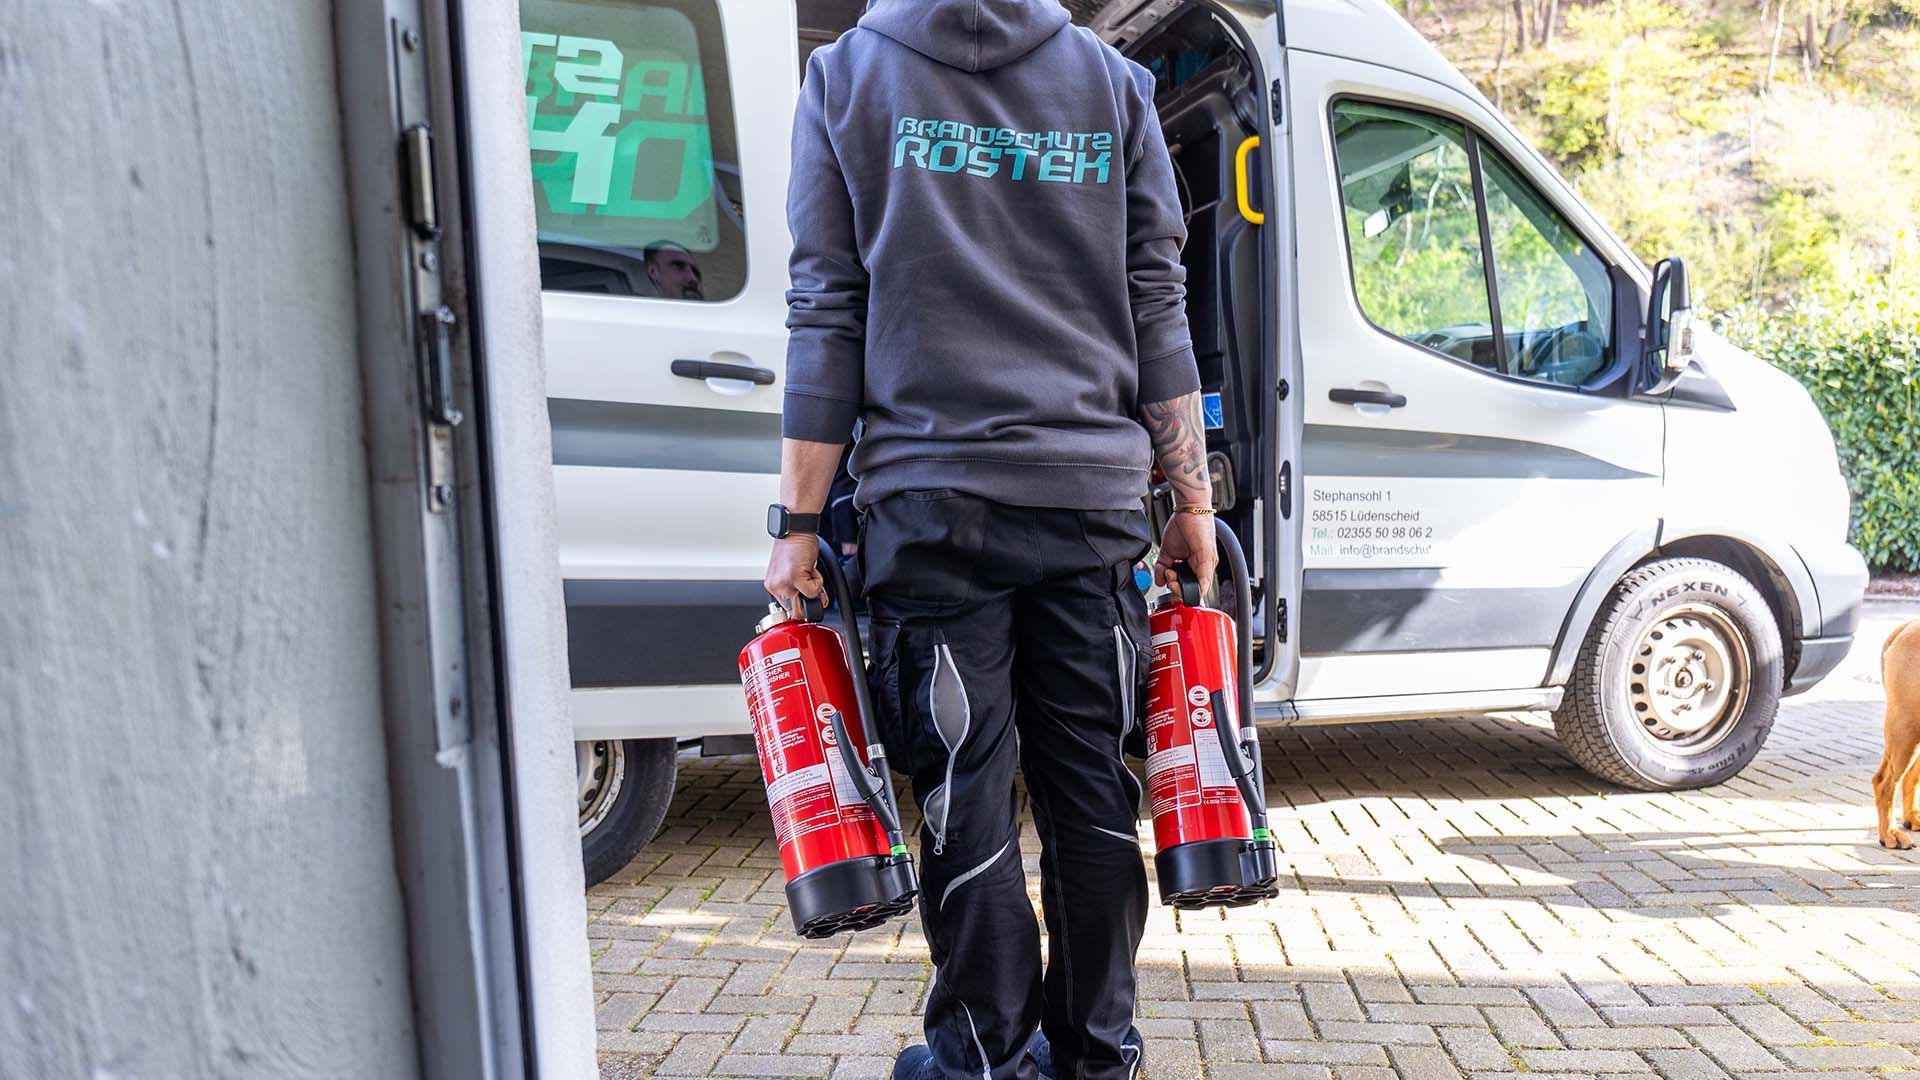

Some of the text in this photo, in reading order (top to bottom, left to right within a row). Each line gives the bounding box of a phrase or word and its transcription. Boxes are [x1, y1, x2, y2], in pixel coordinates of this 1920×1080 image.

[893, 134, 1112, 185] ROSTEK
[1312, 489, 1392, 503] Stephansohl 1
[1311, 509, 1420, 522] 58515 Lüdenscheid
[1336, 527, 1372, 539] 02355
[1375, 527, 1389, 539] 50
[1392, 527, 1406, 539] 98
[1408, 527, 1423, 539] 06
[1425, 527, 1433, 539] 2
[1651, 581, 1729, 607] NEXEN
